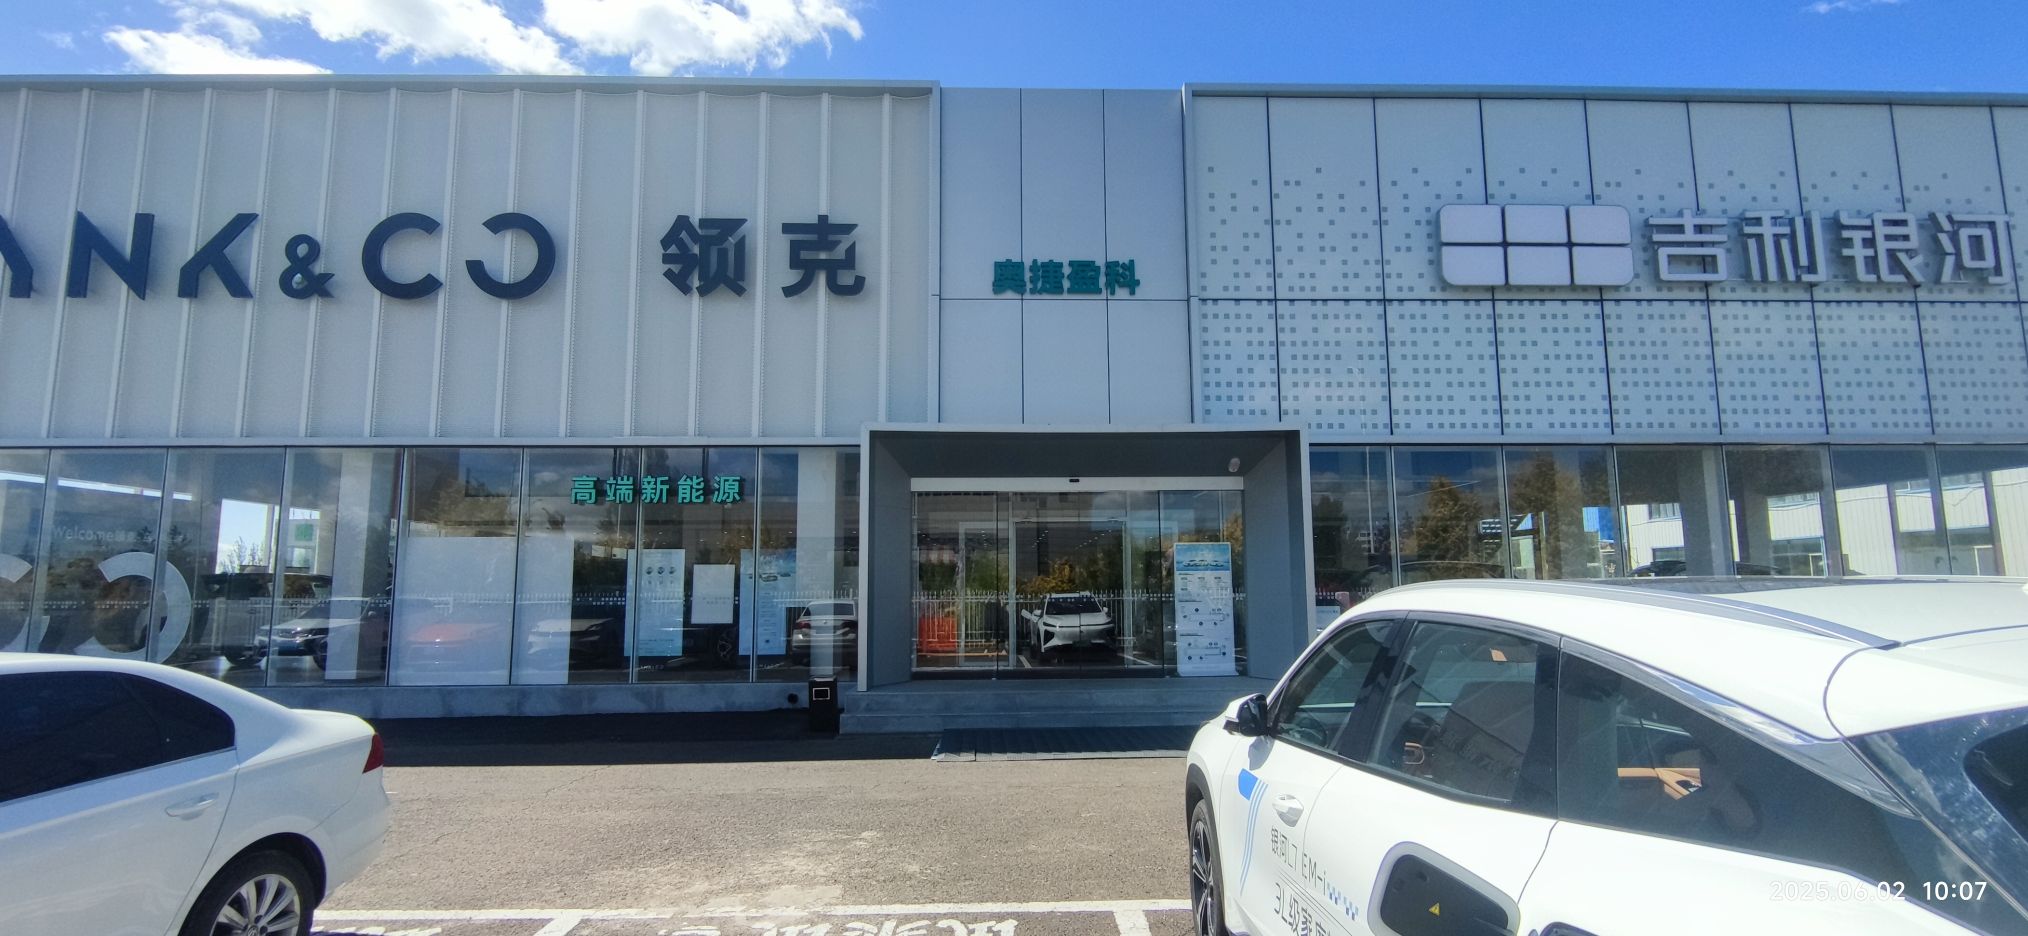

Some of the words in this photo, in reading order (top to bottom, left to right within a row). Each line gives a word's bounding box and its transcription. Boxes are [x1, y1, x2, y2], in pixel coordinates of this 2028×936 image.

[660, 214, 866, 298] 领克
[1647, 209, 2013, 285] 吉利银河
[992, 258, 1141, 296] 奥捷盈科
[570, 474, 743, 504] 高端新能源
